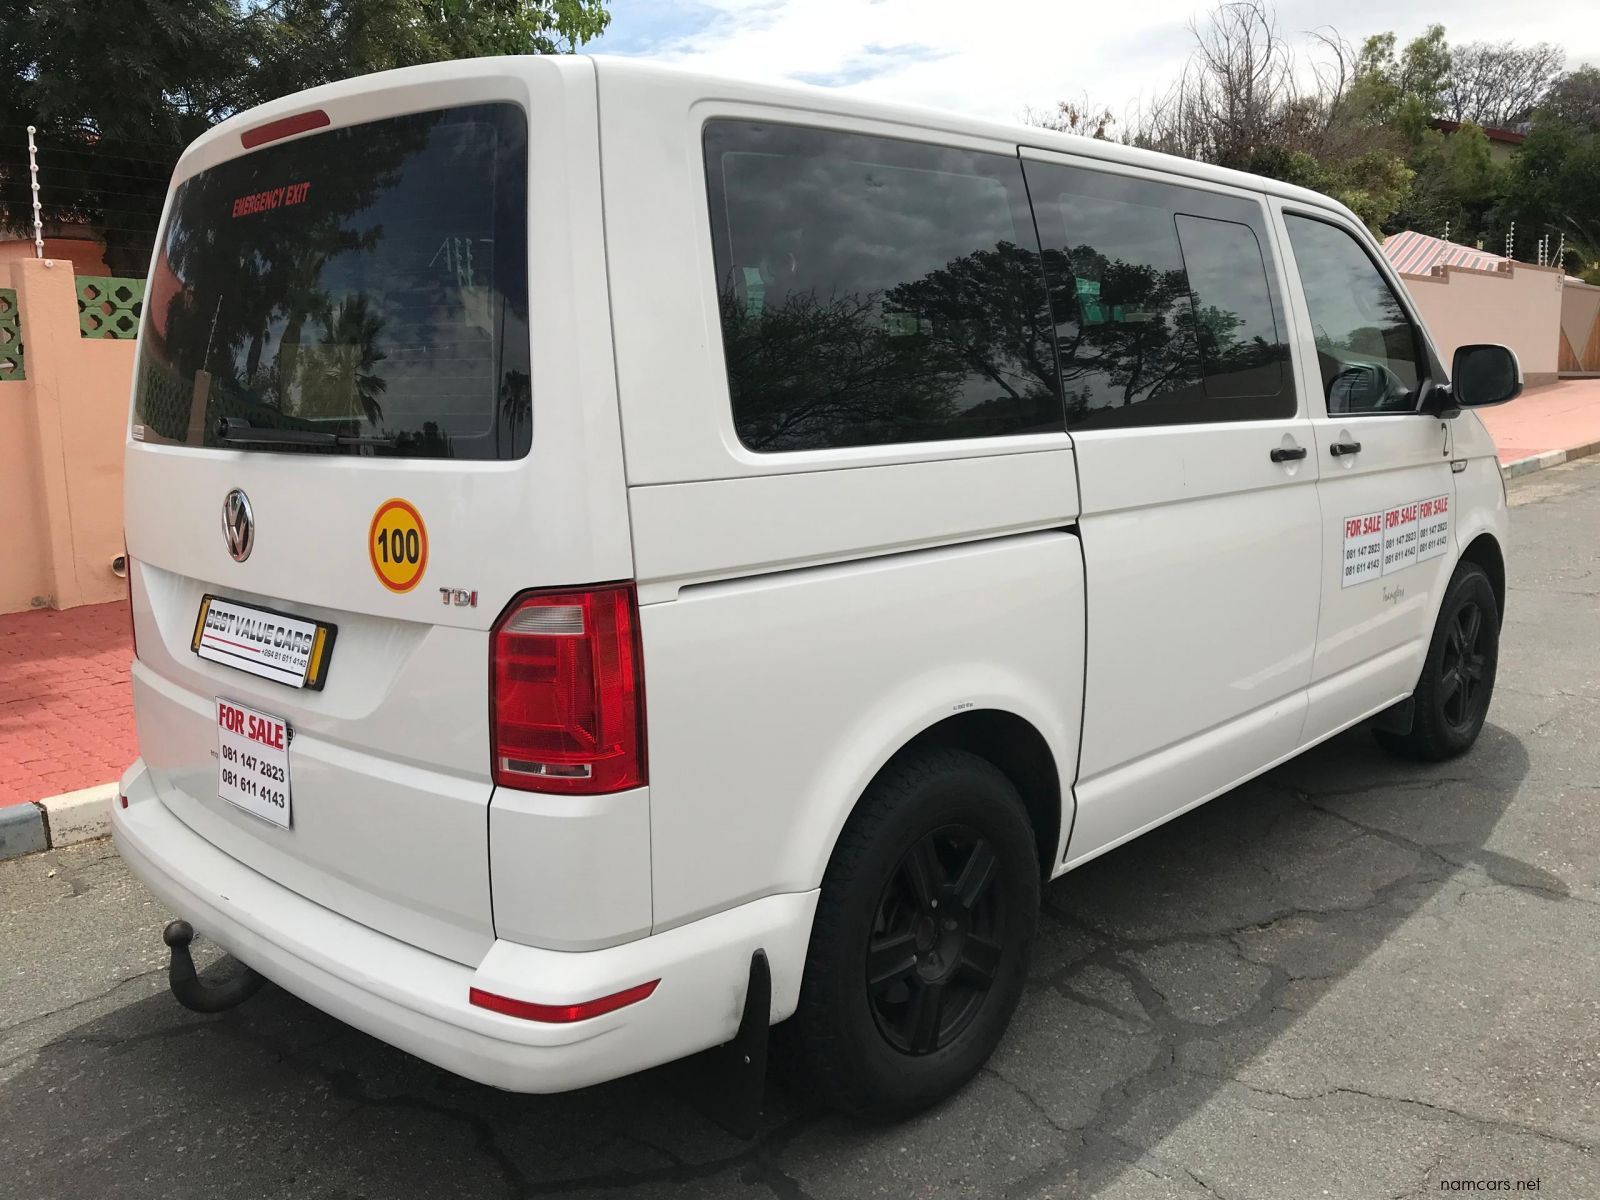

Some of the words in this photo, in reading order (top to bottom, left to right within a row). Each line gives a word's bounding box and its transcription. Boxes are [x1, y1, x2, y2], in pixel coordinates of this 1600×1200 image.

[232, 187, 285, 218] EMERGENCY
[285, 182, 310, 206] EXIT
[1385, 510, 1399, 529] FOR
[1401, 505, 1417, 524] SALE
[1420, 502, 1432, 519] FOR
[1434, 498, 1448, 515] SALE
[1346, 519, 1361, 538] FOR
[1363, 516, 1381, 535] SALE
[378, 528, 419, 564] 100
[1346, 549, 1356, 560] 081
[1358, 545, 1367, 557] 147
[1368, 543, 1380, 554] 2823
[1386, 538, 1394, 549] 081
[1345, 564, 1355, 576] 081
[1356, 562, 1366, 574] 611
[1367, 559, 1380, 570] 4143
[1385, 554, 1394, 565] 081
[439, 587, 478, 608] TDI
[205, 609, 236, 634] BEST
[236, 615, 275, 645] VALUE
[273, 626, 313, 655] CARS
[261, 649, 275, 658] +264
[274, 651, 282, 661] 81
[281, 654, 292, 664] 611
[292, 657, 307, 668] 4143
[218, 702, 245, 735] FOR
[248, 714, 284, 750] SALE
[222, 744, 238, 764] 081
[240, 753, 257, 772] 147
[259, 760, 286, 783] 2823
[222, 768, 238, 788] 081
[240, 776, 257, 797] 611
[259, 785, 286, 809] 4143
